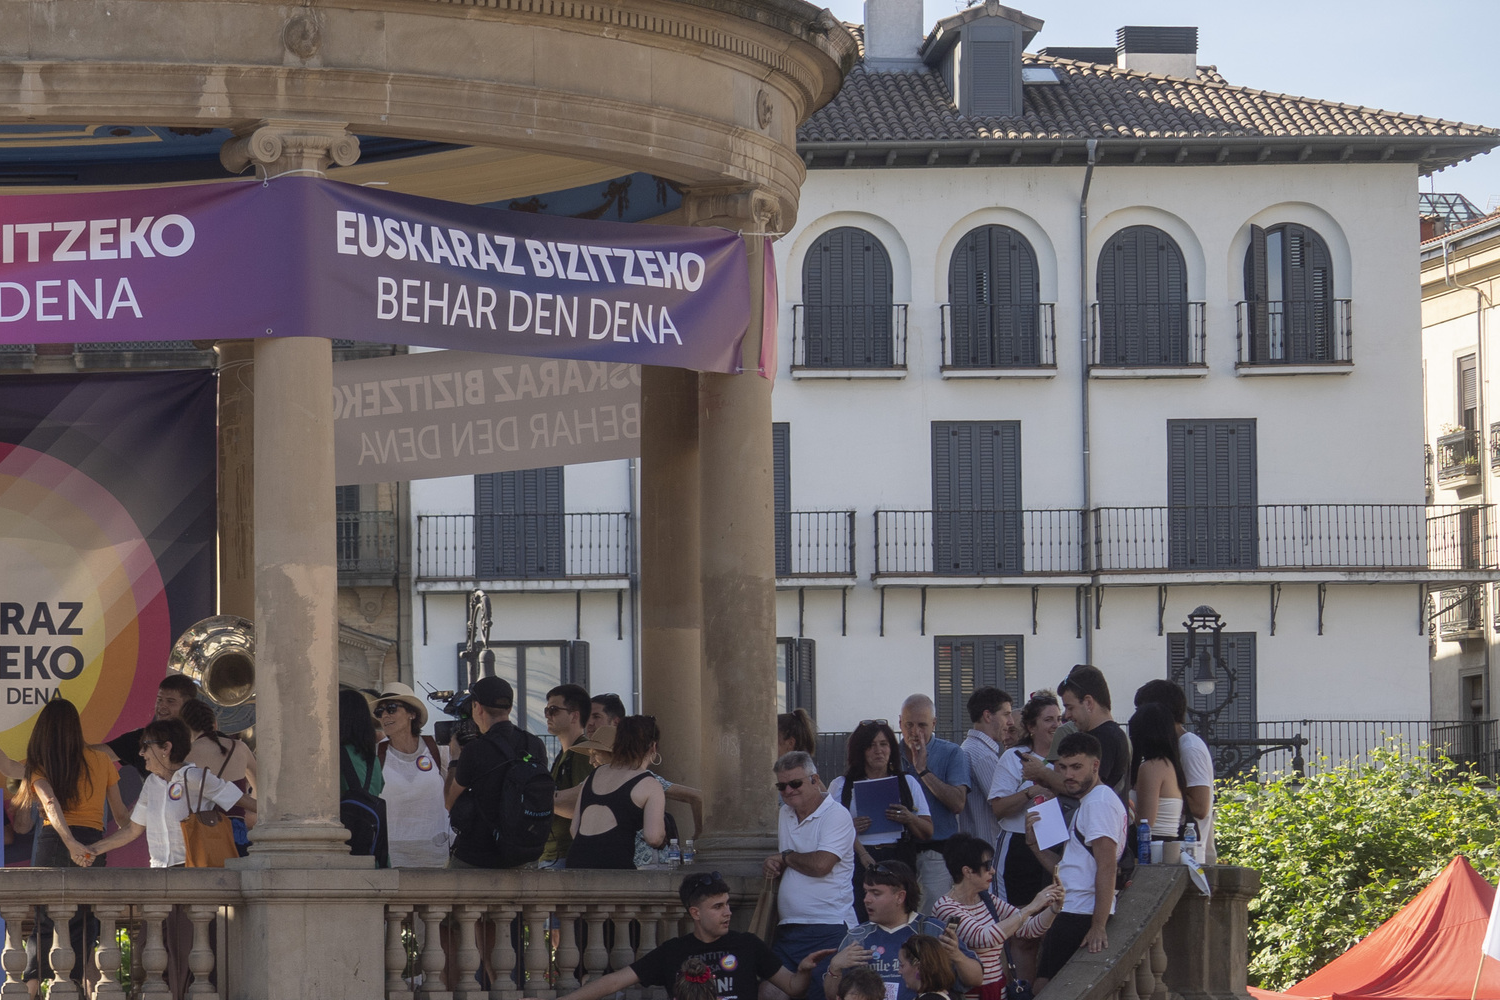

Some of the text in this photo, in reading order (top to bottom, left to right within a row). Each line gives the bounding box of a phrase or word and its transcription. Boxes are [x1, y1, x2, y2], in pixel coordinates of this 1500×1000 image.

[336, 209, 706, 293] EUSKARAZ BIZITZEKO
[376, 275, 683, 346] BEHAR DEN DENA
[6, 687, 63, 705] DENA
